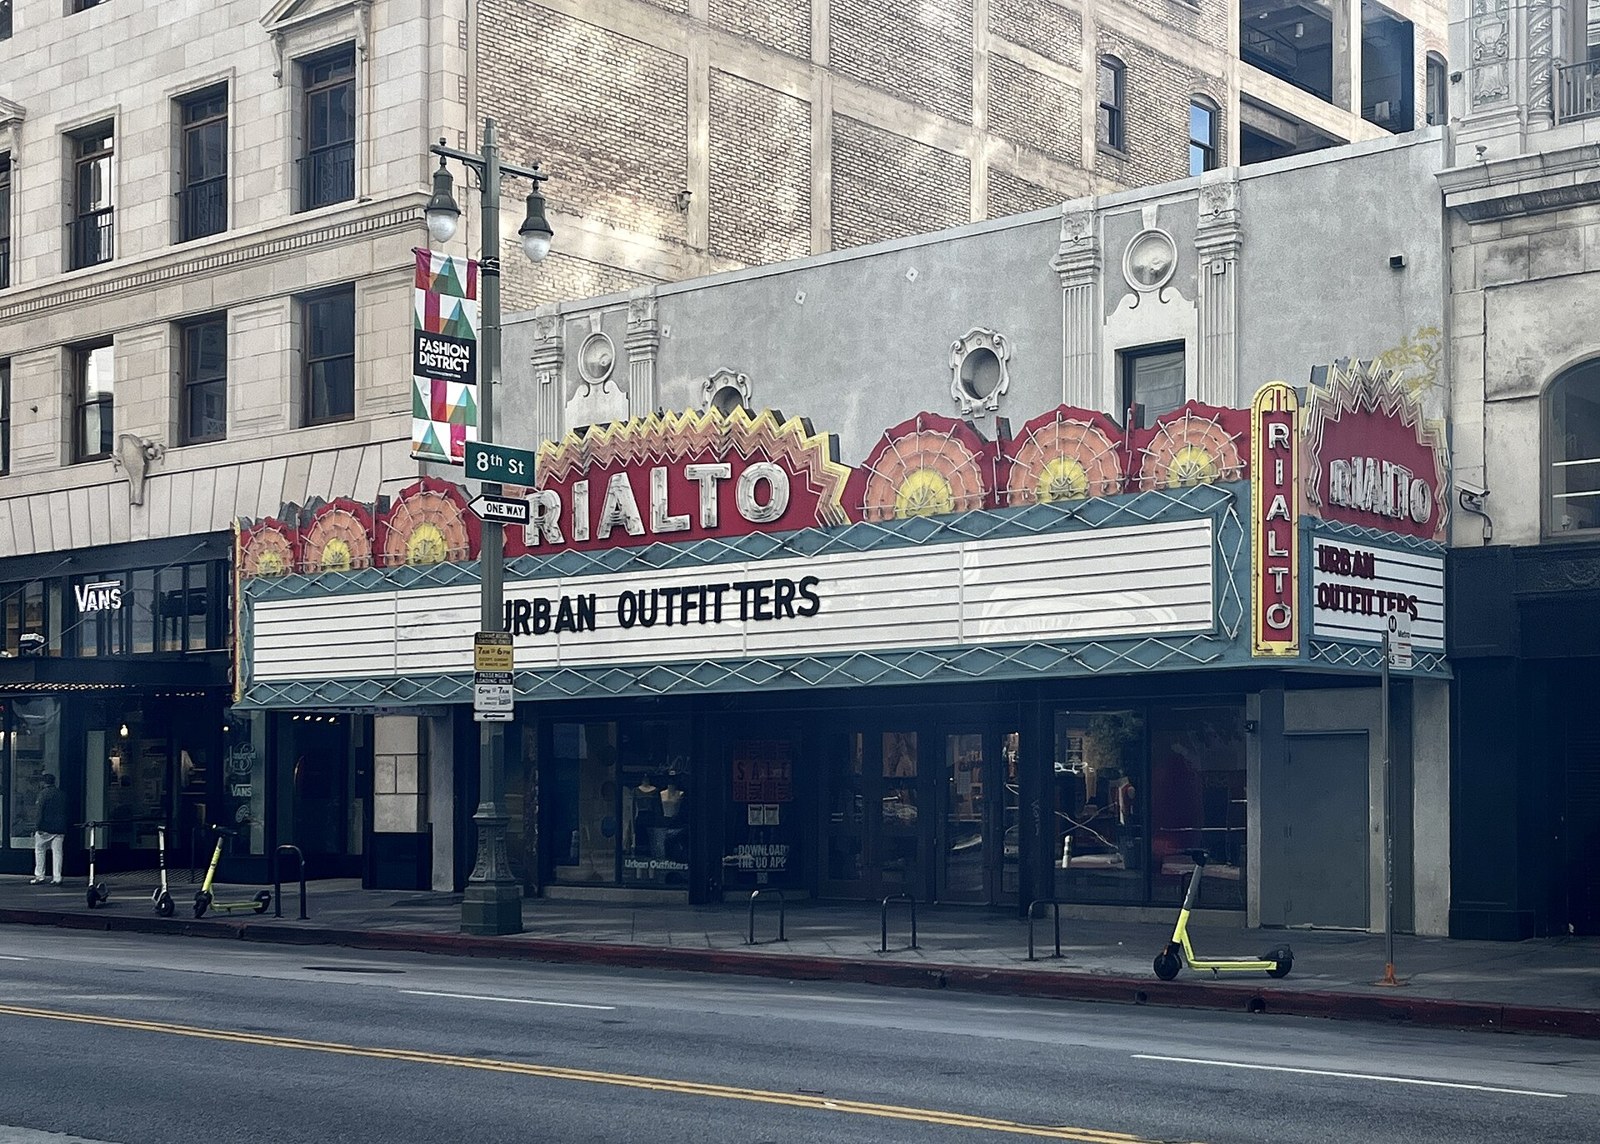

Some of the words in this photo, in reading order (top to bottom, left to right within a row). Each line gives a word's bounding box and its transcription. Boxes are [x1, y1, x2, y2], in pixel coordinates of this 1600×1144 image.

[420, 338, 469, 359] FASHION
[419, 351, 469, 372] DISTRICT
[476, 452, 503, 472] 8th
[508, 459, 524, 475] St
[1329, 457, 1432, 524] RIALTO
[486, 503, 504, 514] ONE
[506, 506, 524, 517] WAY
[523, 461, 790, 547] RIALTO
[1266, 422, 1291, 630] RIALTO
[1318, 544, 1375, 580] URBAN
[75, 580, 122, 612] VANS
[617, 576, 820, 629] OUTFITTERS
[231, 784, 252, 797] VANS
[737, 845, 787, 857] DOWNLOAD
[624, 859, 649, 869] Urban
